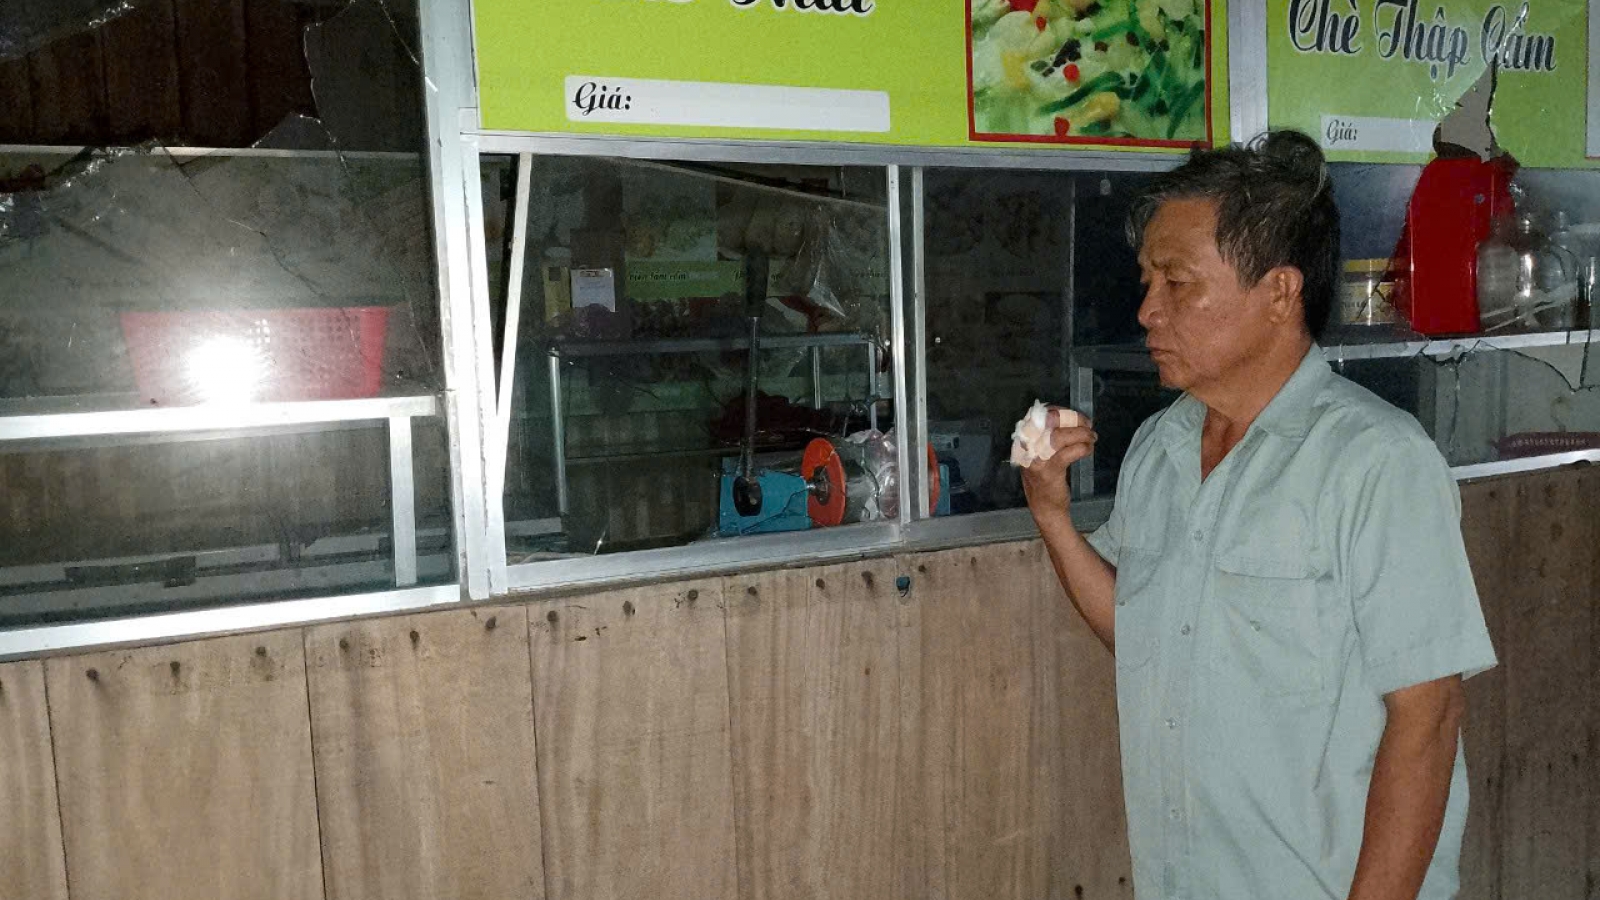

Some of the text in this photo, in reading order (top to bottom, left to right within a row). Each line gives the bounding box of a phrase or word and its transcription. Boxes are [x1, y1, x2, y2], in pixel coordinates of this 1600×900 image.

[1290, 0, 1361, 54] Chè
[1376, 0, 1471, 78] Thập
[572, 82, 632, 116] Giá:
[1326, 119, 1359, 142] Giá:
